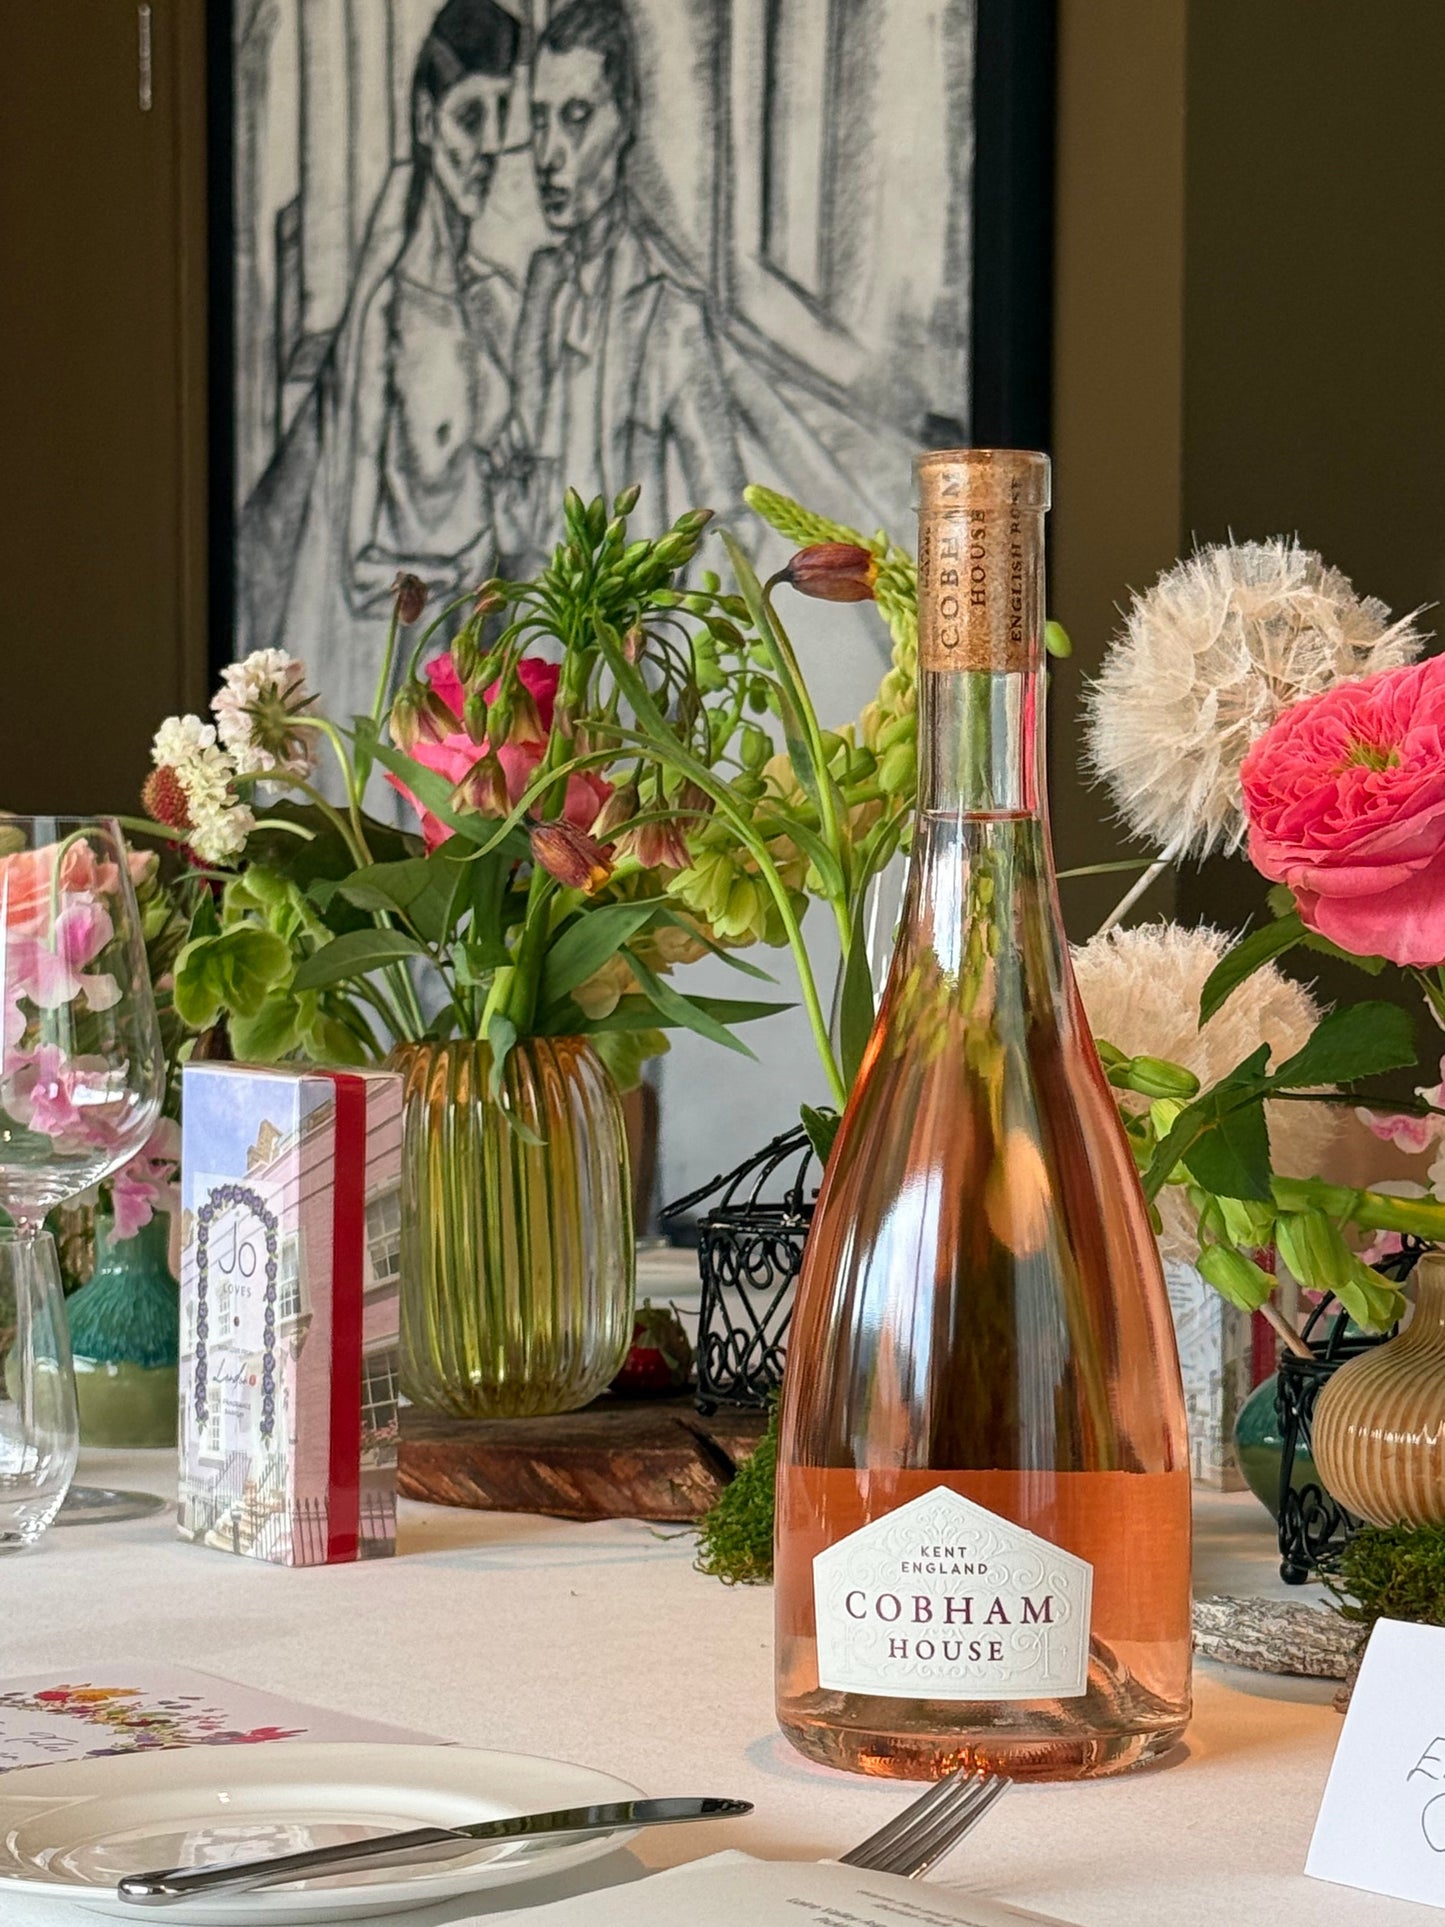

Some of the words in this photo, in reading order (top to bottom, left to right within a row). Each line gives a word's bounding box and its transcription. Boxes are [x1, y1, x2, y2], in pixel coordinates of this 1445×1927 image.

[940, 470, 961, 649] COBHAM
[970, 508, 987, 607] HOUSE
[1010, 544, 1023, 643] ENGLISH
[217, 1220, 257, 1278] Jo
[222, 1284, 252, 1298] LOVES
[901, 1561, 988, 1576] ENGLAND
[920, 1545, 967, 1559] KENT
[845, 1590, 1055, 1625] COBHAM
[887, 1637, 1005, 1662] HOUSE
